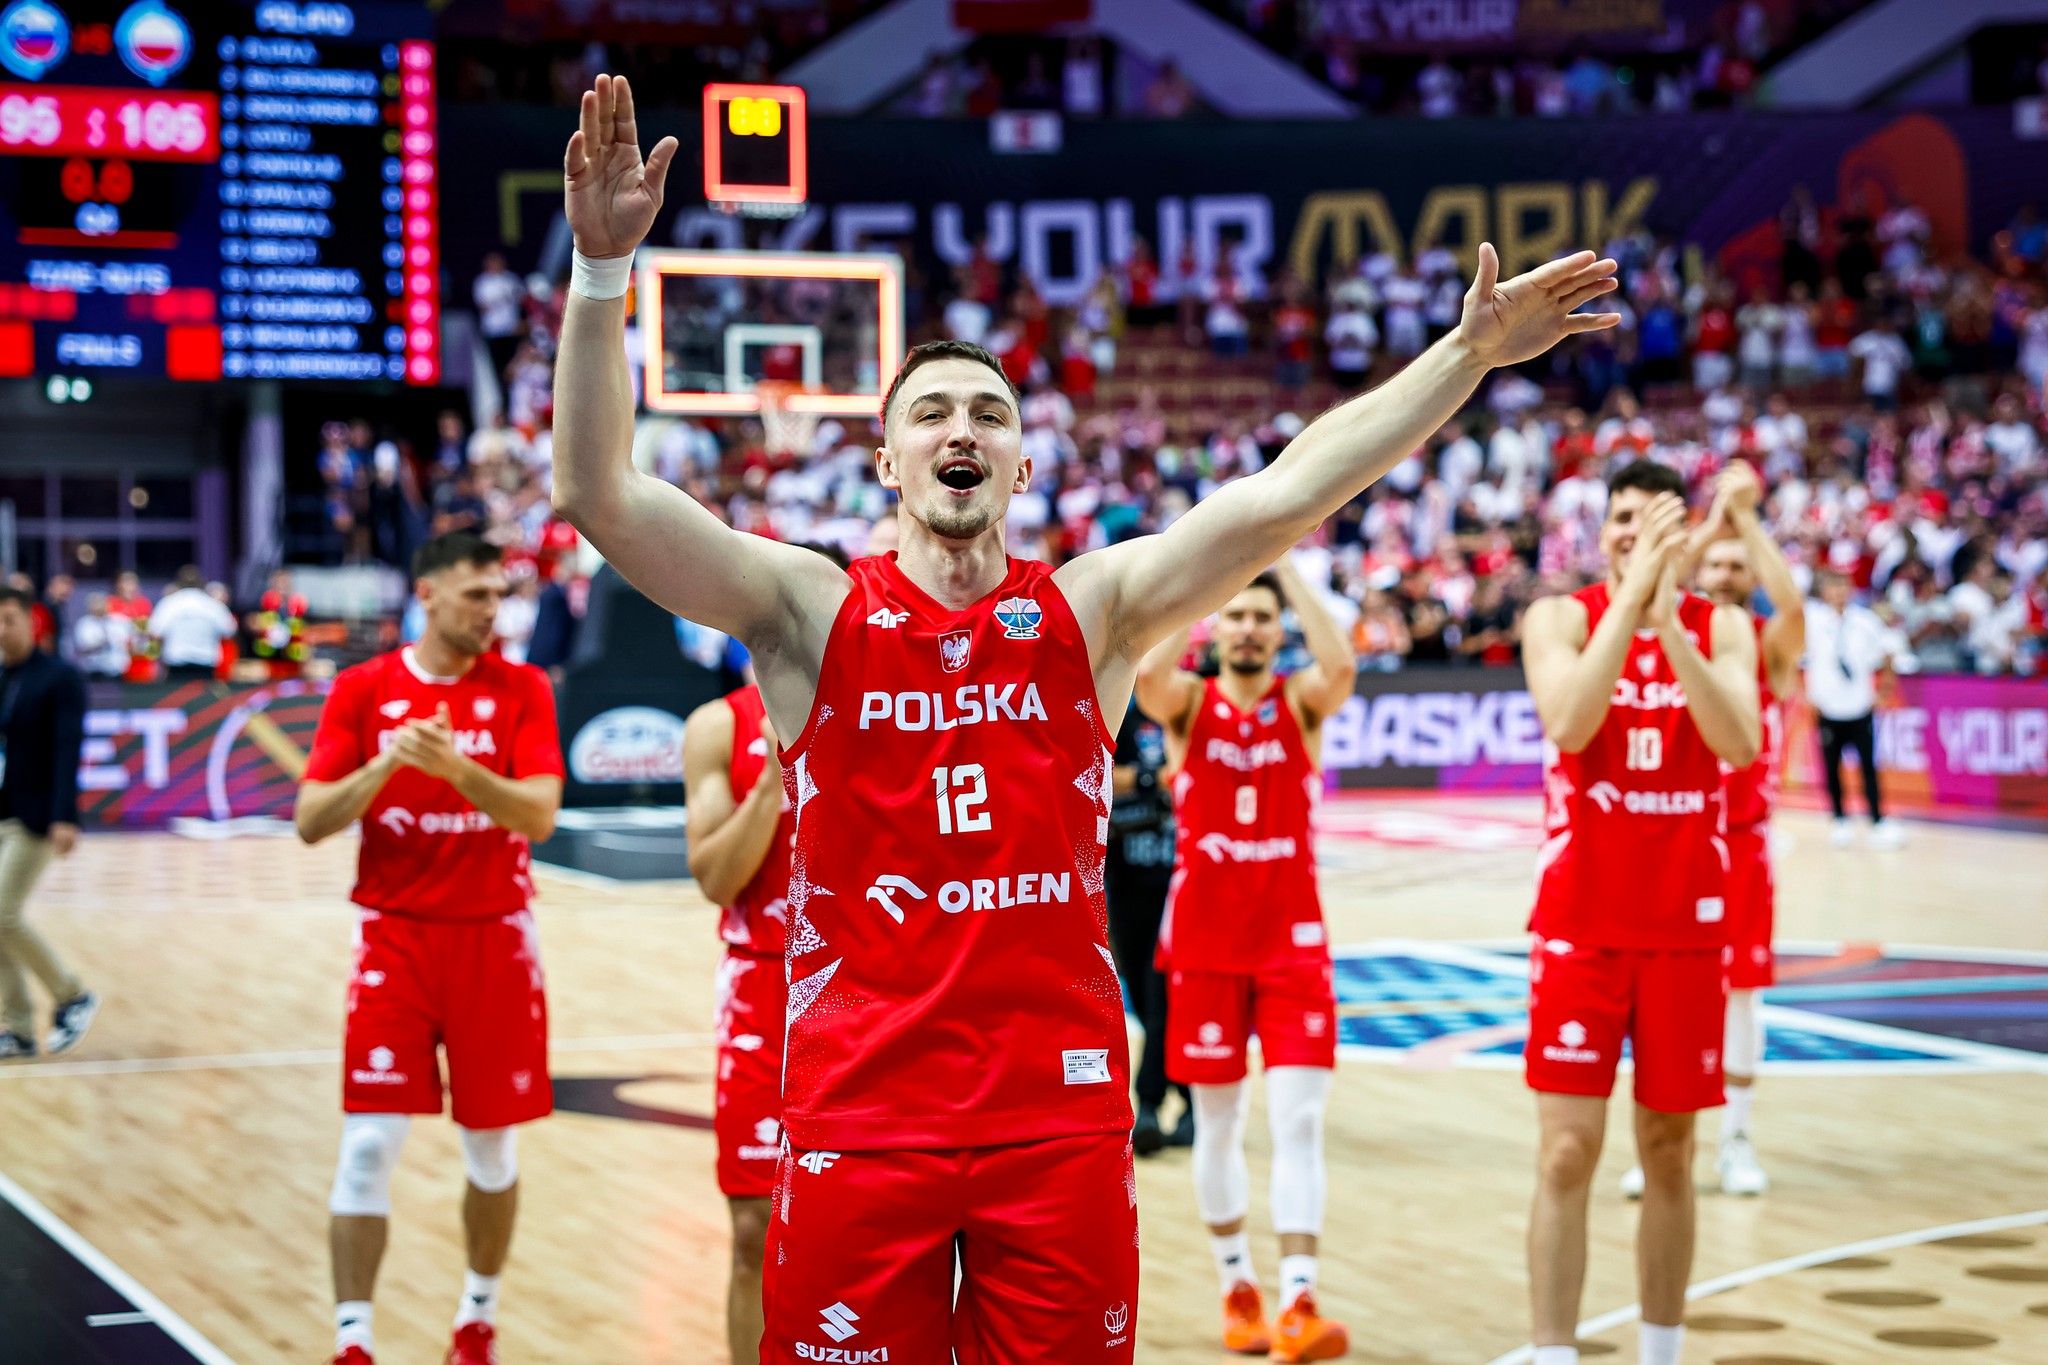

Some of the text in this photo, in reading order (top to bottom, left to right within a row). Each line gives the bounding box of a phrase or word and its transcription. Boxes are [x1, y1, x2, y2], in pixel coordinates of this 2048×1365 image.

[0, 94, 61, 145] 95
[115, 99, 207, 153] 105
[930, 193, 1275, 302] YOUR
[1287, 177, 1659, 290] MARK
[858, 682, 1049, 732] POLSKA
[1626, 727, 1662, 771] 10
[931, 763, 993, 835] 12
[1624, 789, 1705, 815] ORLEN
[937, 871, 1071, 914] ORLEN
[797, 1150, 842, 1175] 4F
[795, 1341, 889, 1365] SUZUKI
